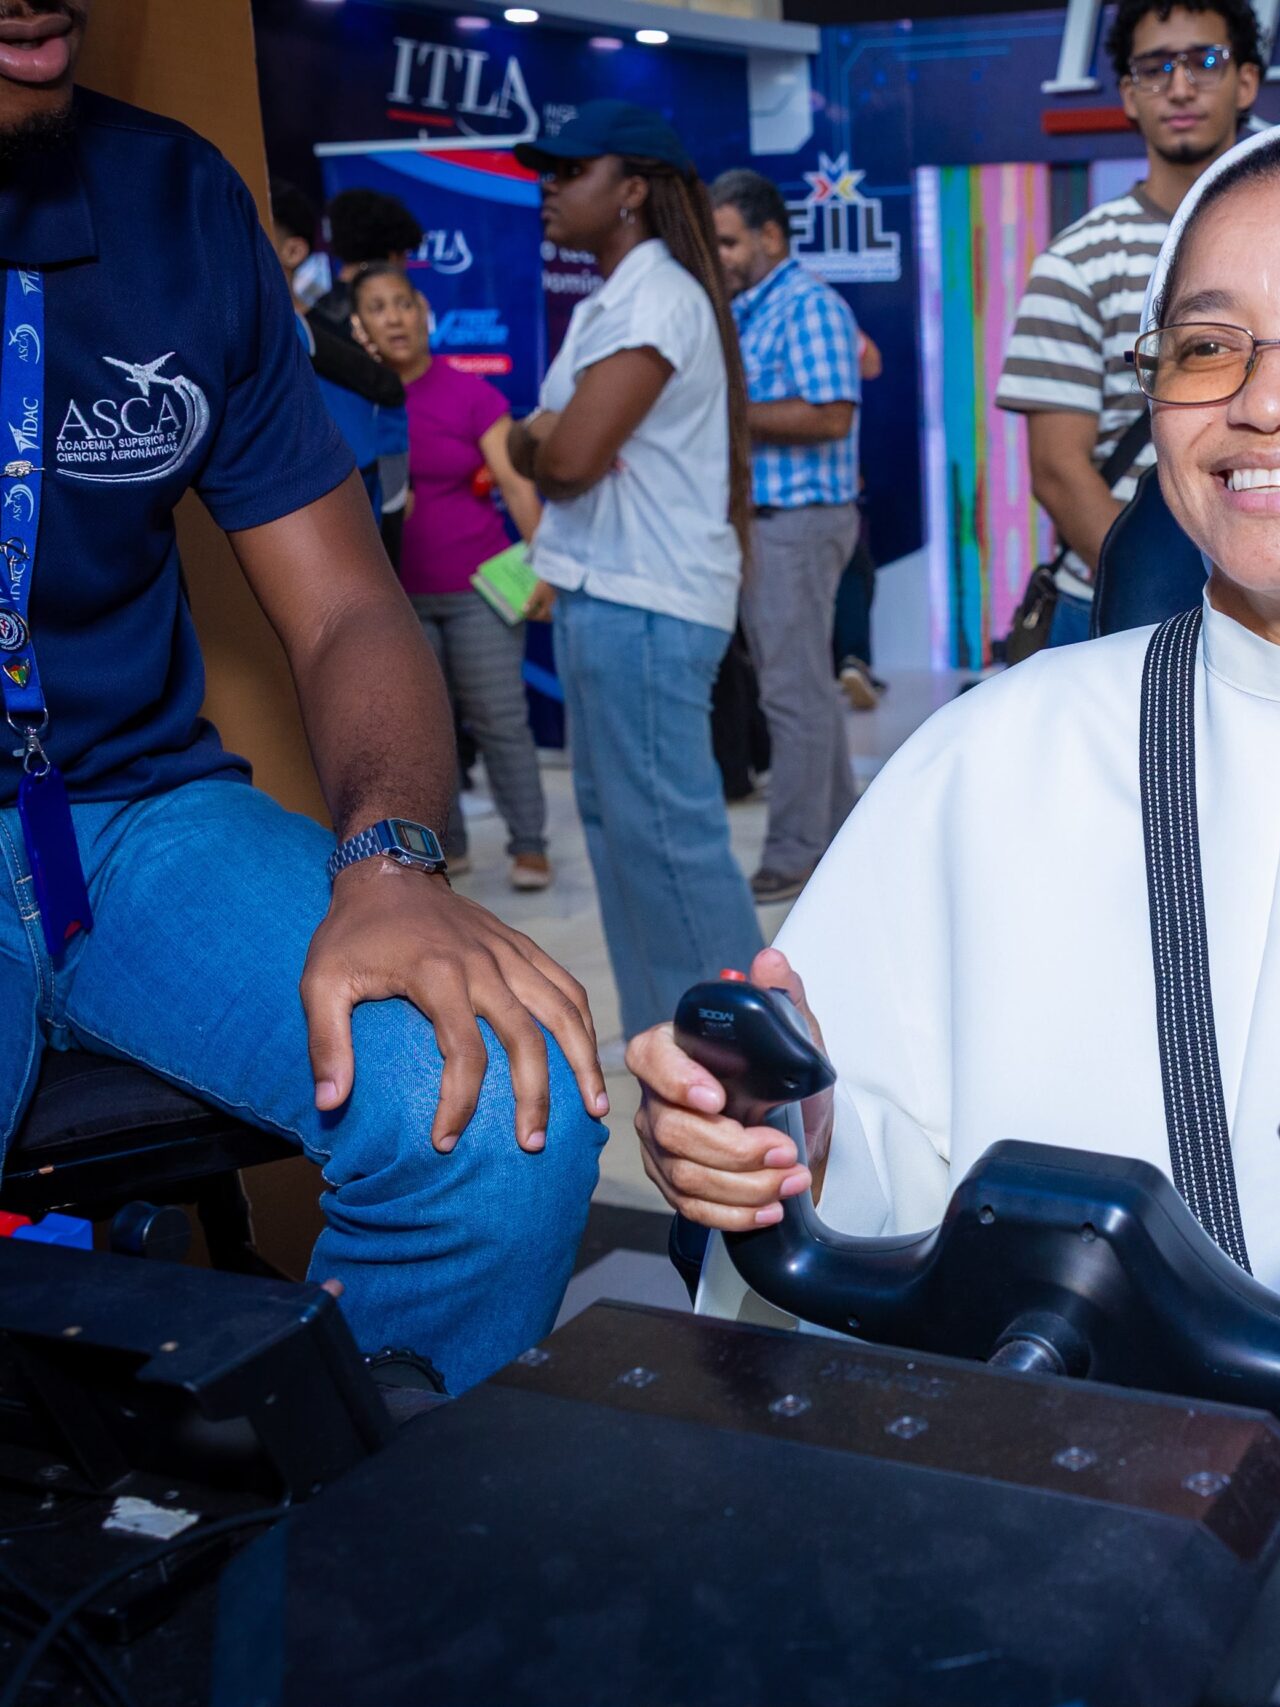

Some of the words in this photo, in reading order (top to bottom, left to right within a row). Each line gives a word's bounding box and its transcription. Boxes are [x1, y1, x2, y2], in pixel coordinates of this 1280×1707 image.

[386, 36, 540, 140] ITLA
[18, 333, 29, 362] ASCA
[23, 397, 39, 439] IDAC
[56, 393, 182, 440] ASCA
[56, 439, 115, 451] ACADEMIA
[118, 433, 165, 448] SUPERIOR
[166, 431, 178, 442] DE
[56, 452, 107, 462] CIENCIAS
[698, 1008, 734, 1021] MODE
